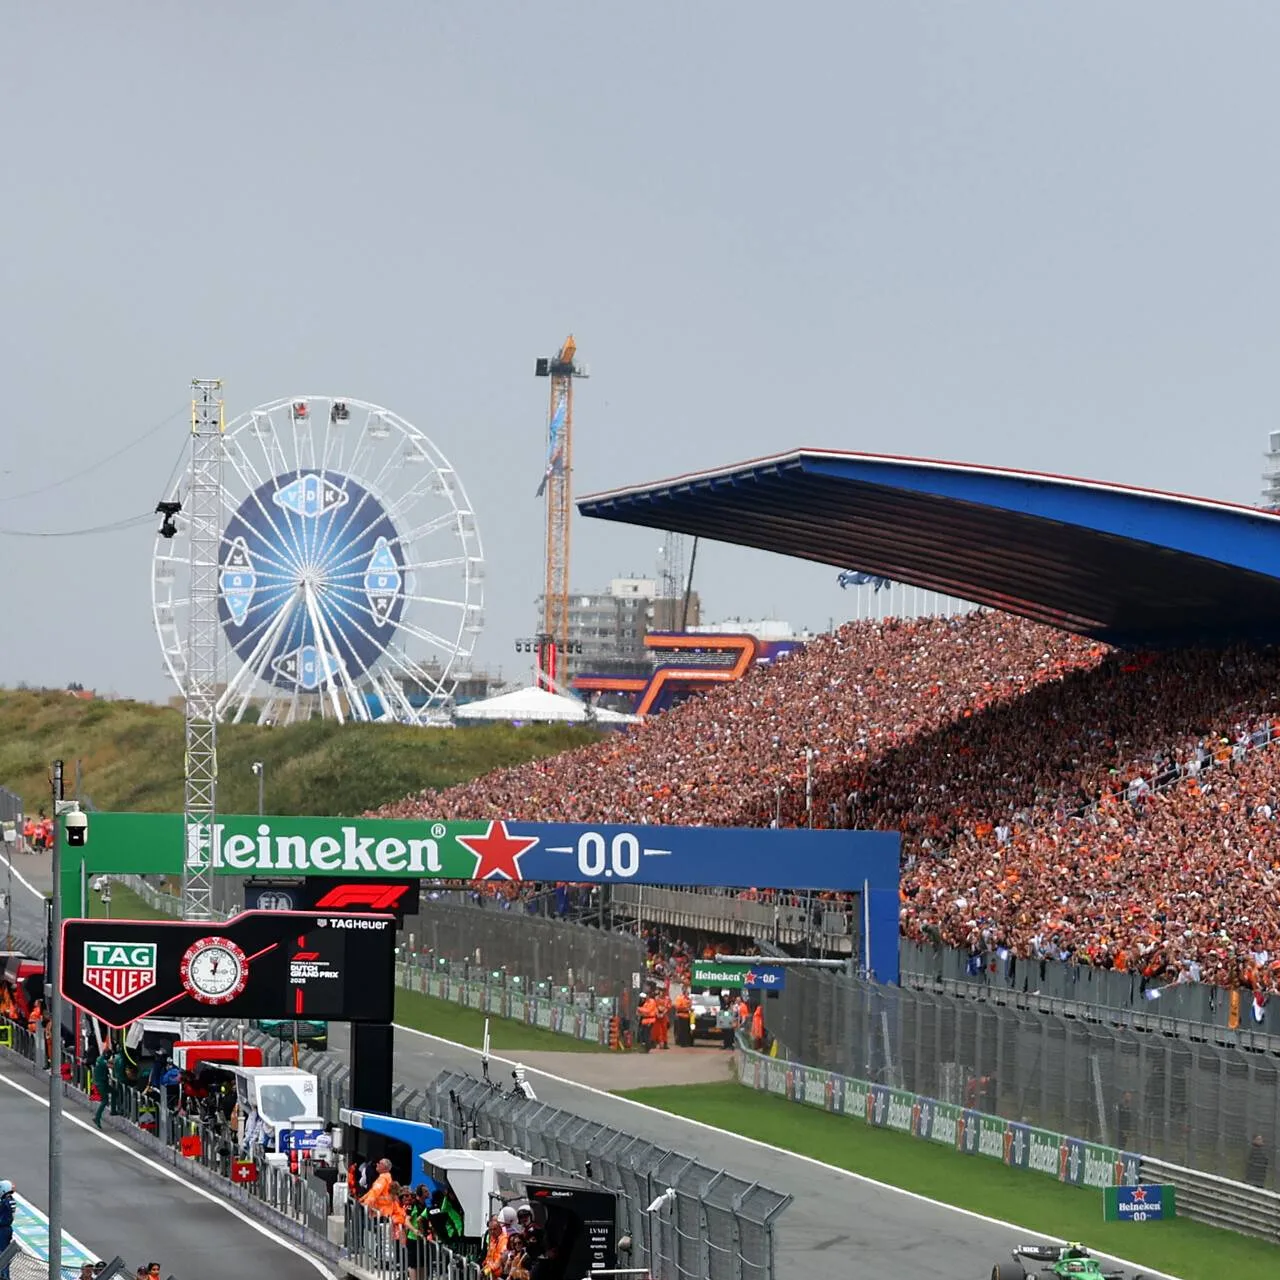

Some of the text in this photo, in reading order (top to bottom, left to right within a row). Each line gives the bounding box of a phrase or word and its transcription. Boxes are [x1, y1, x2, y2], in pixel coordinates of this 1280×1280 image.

[187, 823, 640, 877] Heineken 0.0
[90, 946, 150, 965] TAG
[88, 970, 152, 998] HEUER
[696, 970, 740, 981] Heineken
[1119, 1202, 1161, 1211] Heineken
